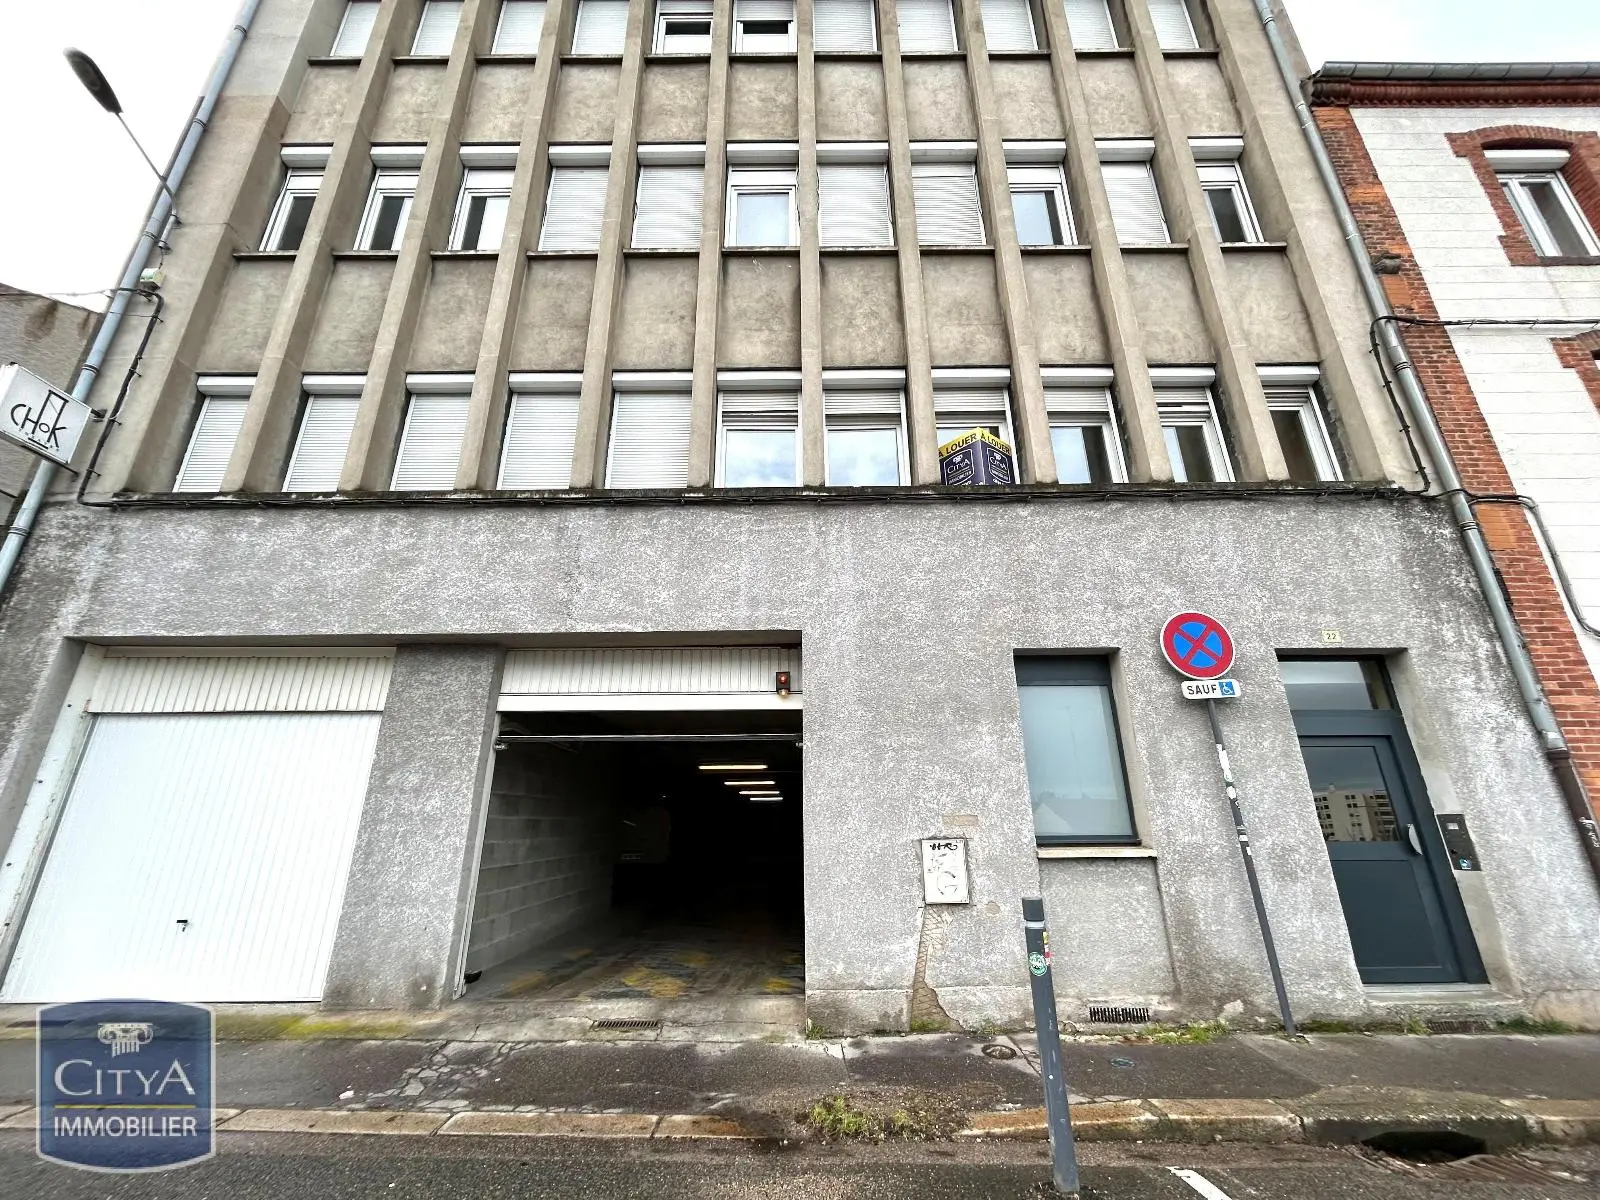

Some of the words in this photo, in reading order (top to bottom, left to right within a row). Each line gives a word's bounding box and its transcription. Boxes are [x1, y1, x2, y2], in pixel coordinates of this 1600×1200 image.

[946, 433, 977, 454] LOUER
[1326, 632, 1337, 640] 22
[1187, 685, 1217, 695] SAUF
